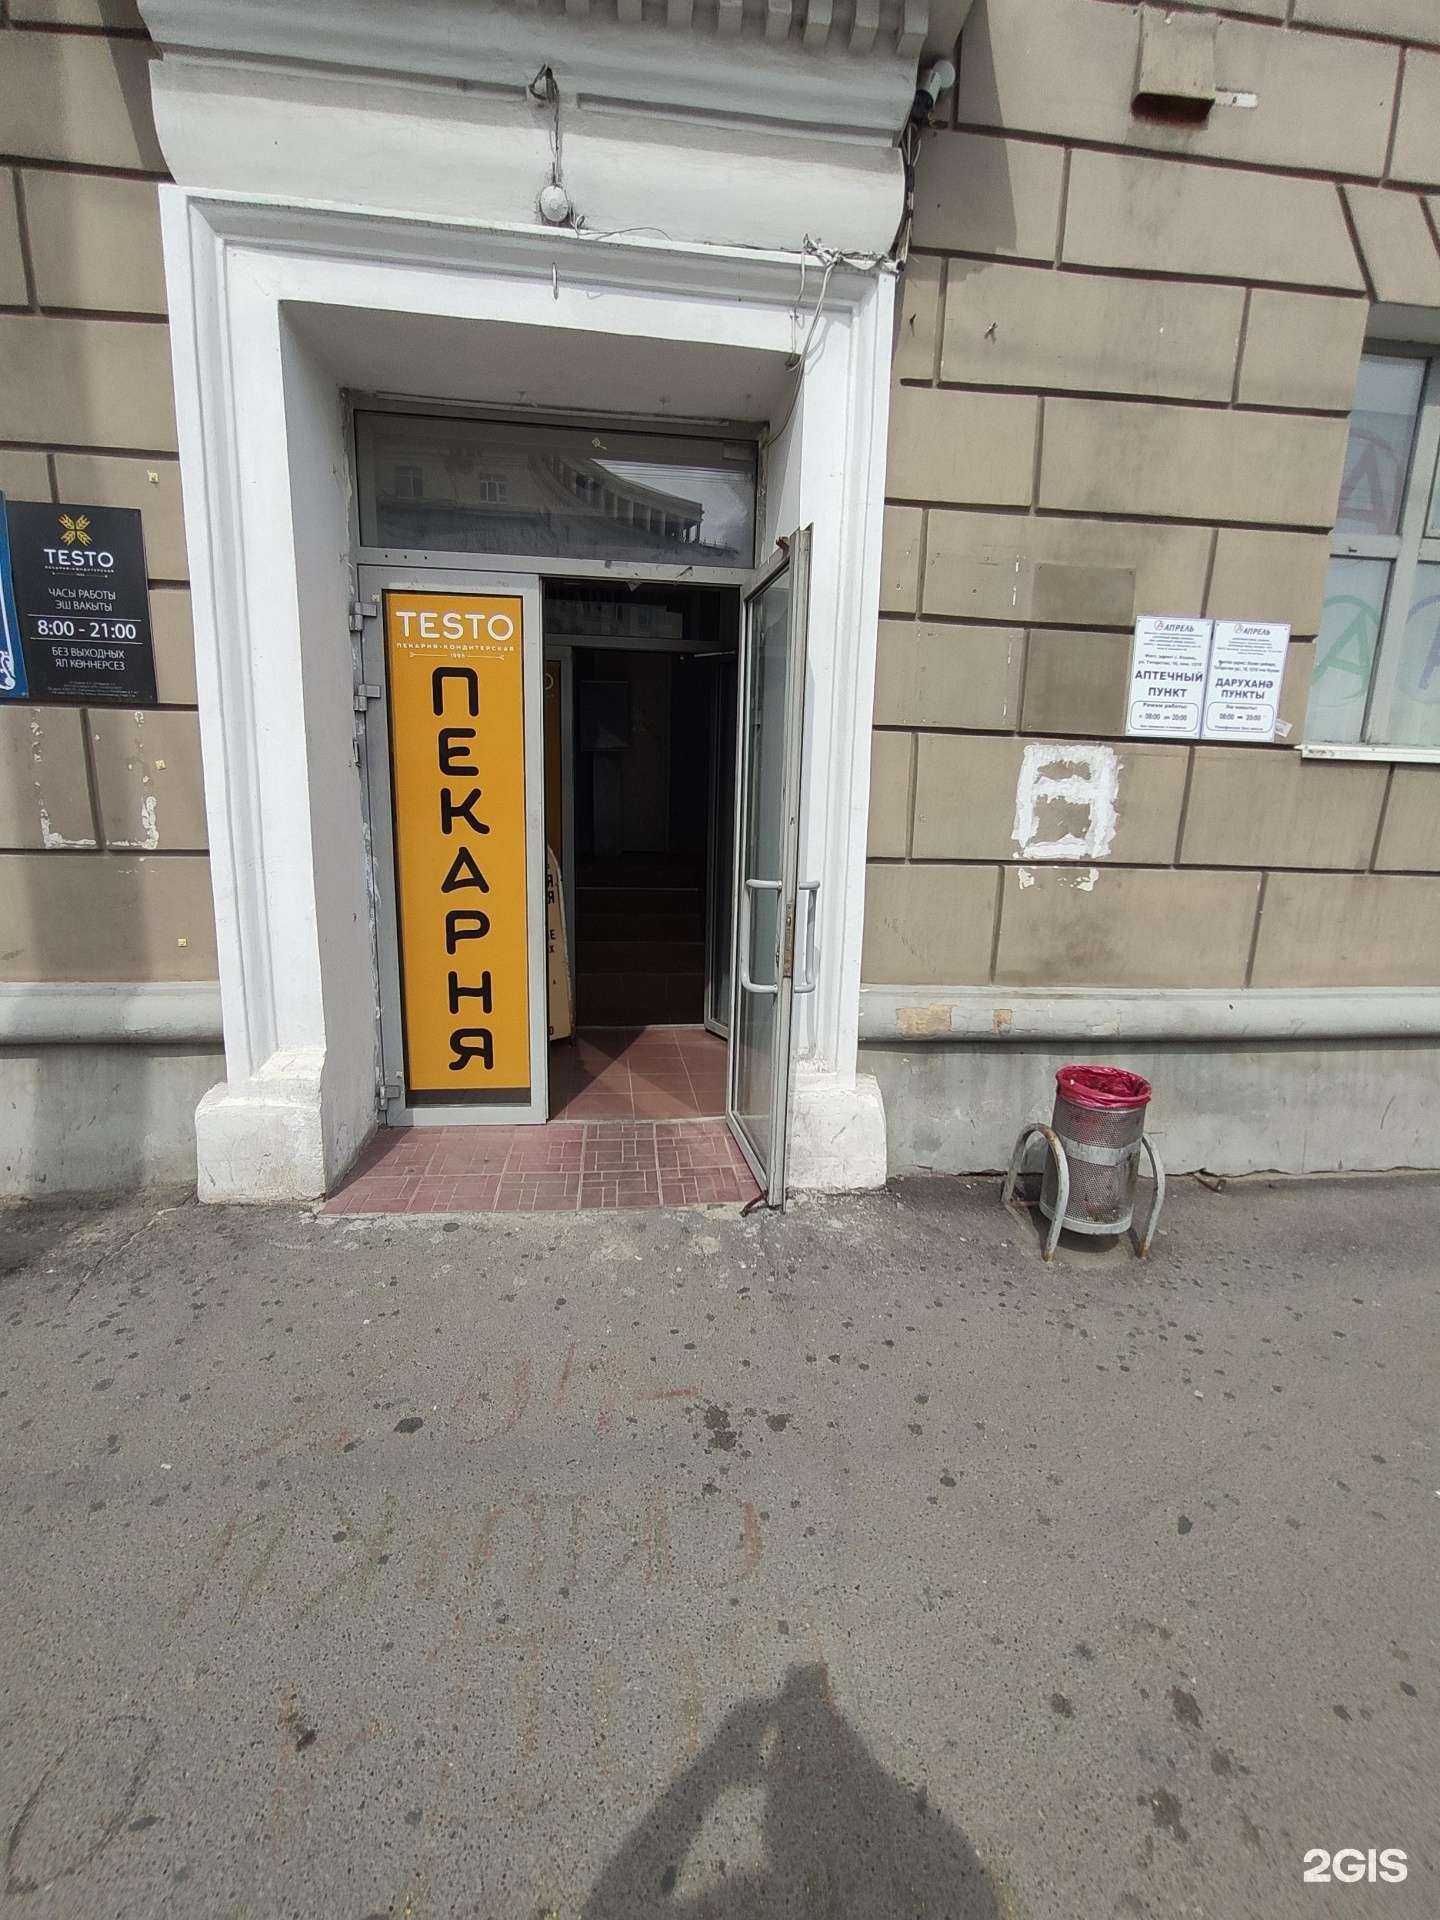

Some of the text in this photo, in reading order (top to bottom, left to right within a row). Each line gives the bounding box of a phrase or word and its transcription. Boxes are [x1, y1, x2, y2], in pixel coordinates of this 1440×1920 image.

[43, 549, 114, 568] TESTO
[48, 588, 116, 600] ЧАСЫ РАБОТЫ
[56, 600, 113, 612] ЭШ ВАКЫТЫ
[38, 620, 75, 636] 8:00
[89, 622, 137, 639] 21:00
[395, 611, 514, 641] TESTO
[1163, 623, 1194, 633] АПРЕЛЬ
[1243, 627, 1271, 636] АПРЕЛЬ
[52, 647, 125, 659] БЕЗ ВЫХОДНЫХ
[55, 659, 68, 668] ЯЛ
[1134, 670, 1203, 682] АПТЕЧНЫЙ
[1215, 678, 1274, 689] ДАРУХАНӘ
[1148, 687, 1187, 698] ПУНКТ
[1221, 690, 1265, 700] ПУНКТЫ
[431, 666, 494, 1071] ПЕКАРНЯ
